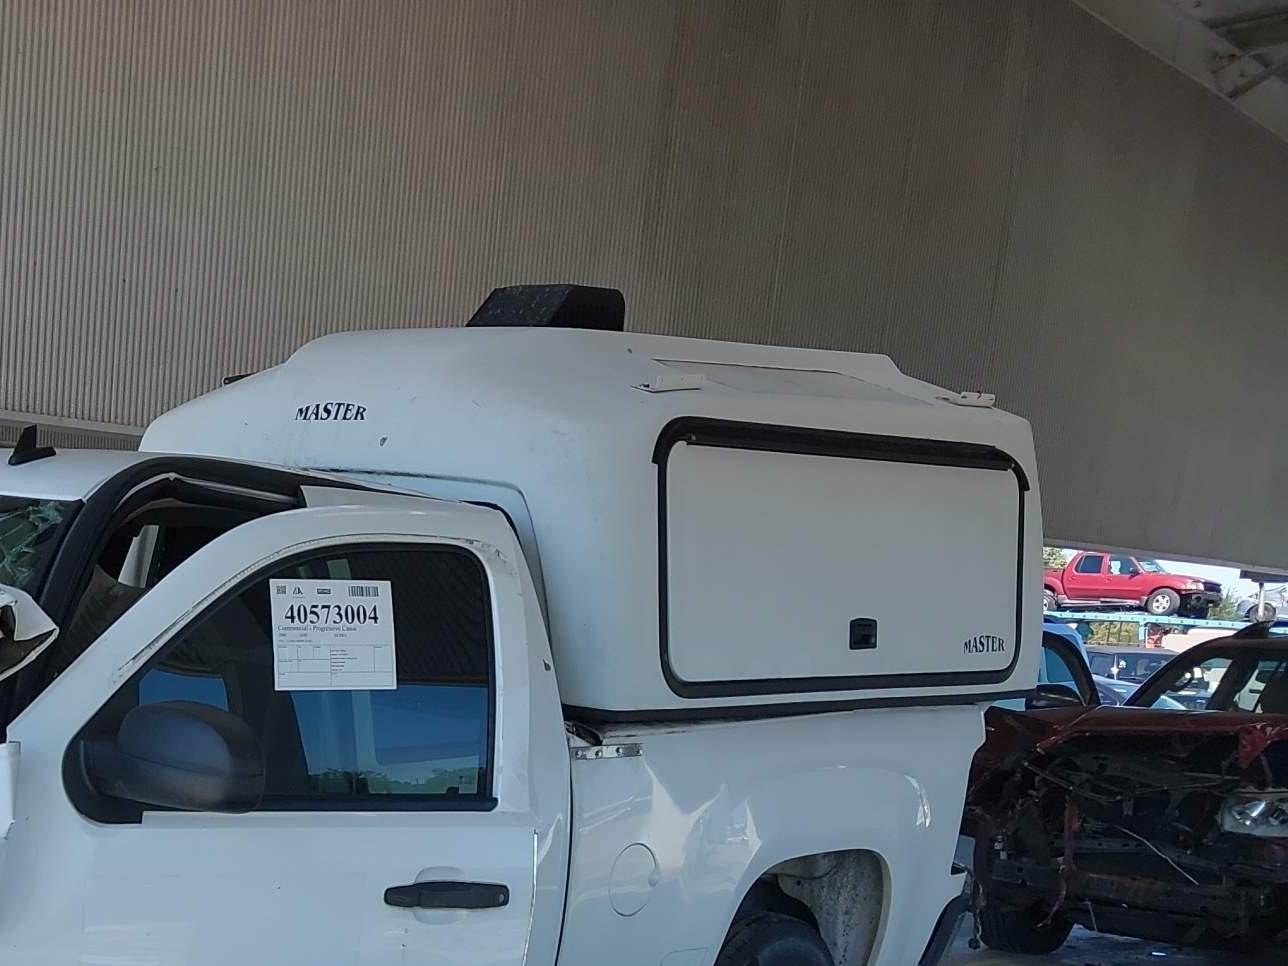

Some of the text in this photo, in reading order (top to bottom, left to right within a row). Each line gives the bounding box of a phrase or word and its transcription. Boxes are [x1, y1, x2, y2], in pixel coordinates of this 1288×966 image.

[295, 402, 367, 421] MASTER
[284, 604, 379, 625] 40573004
[963, 635, 1005, 655] MASTER
